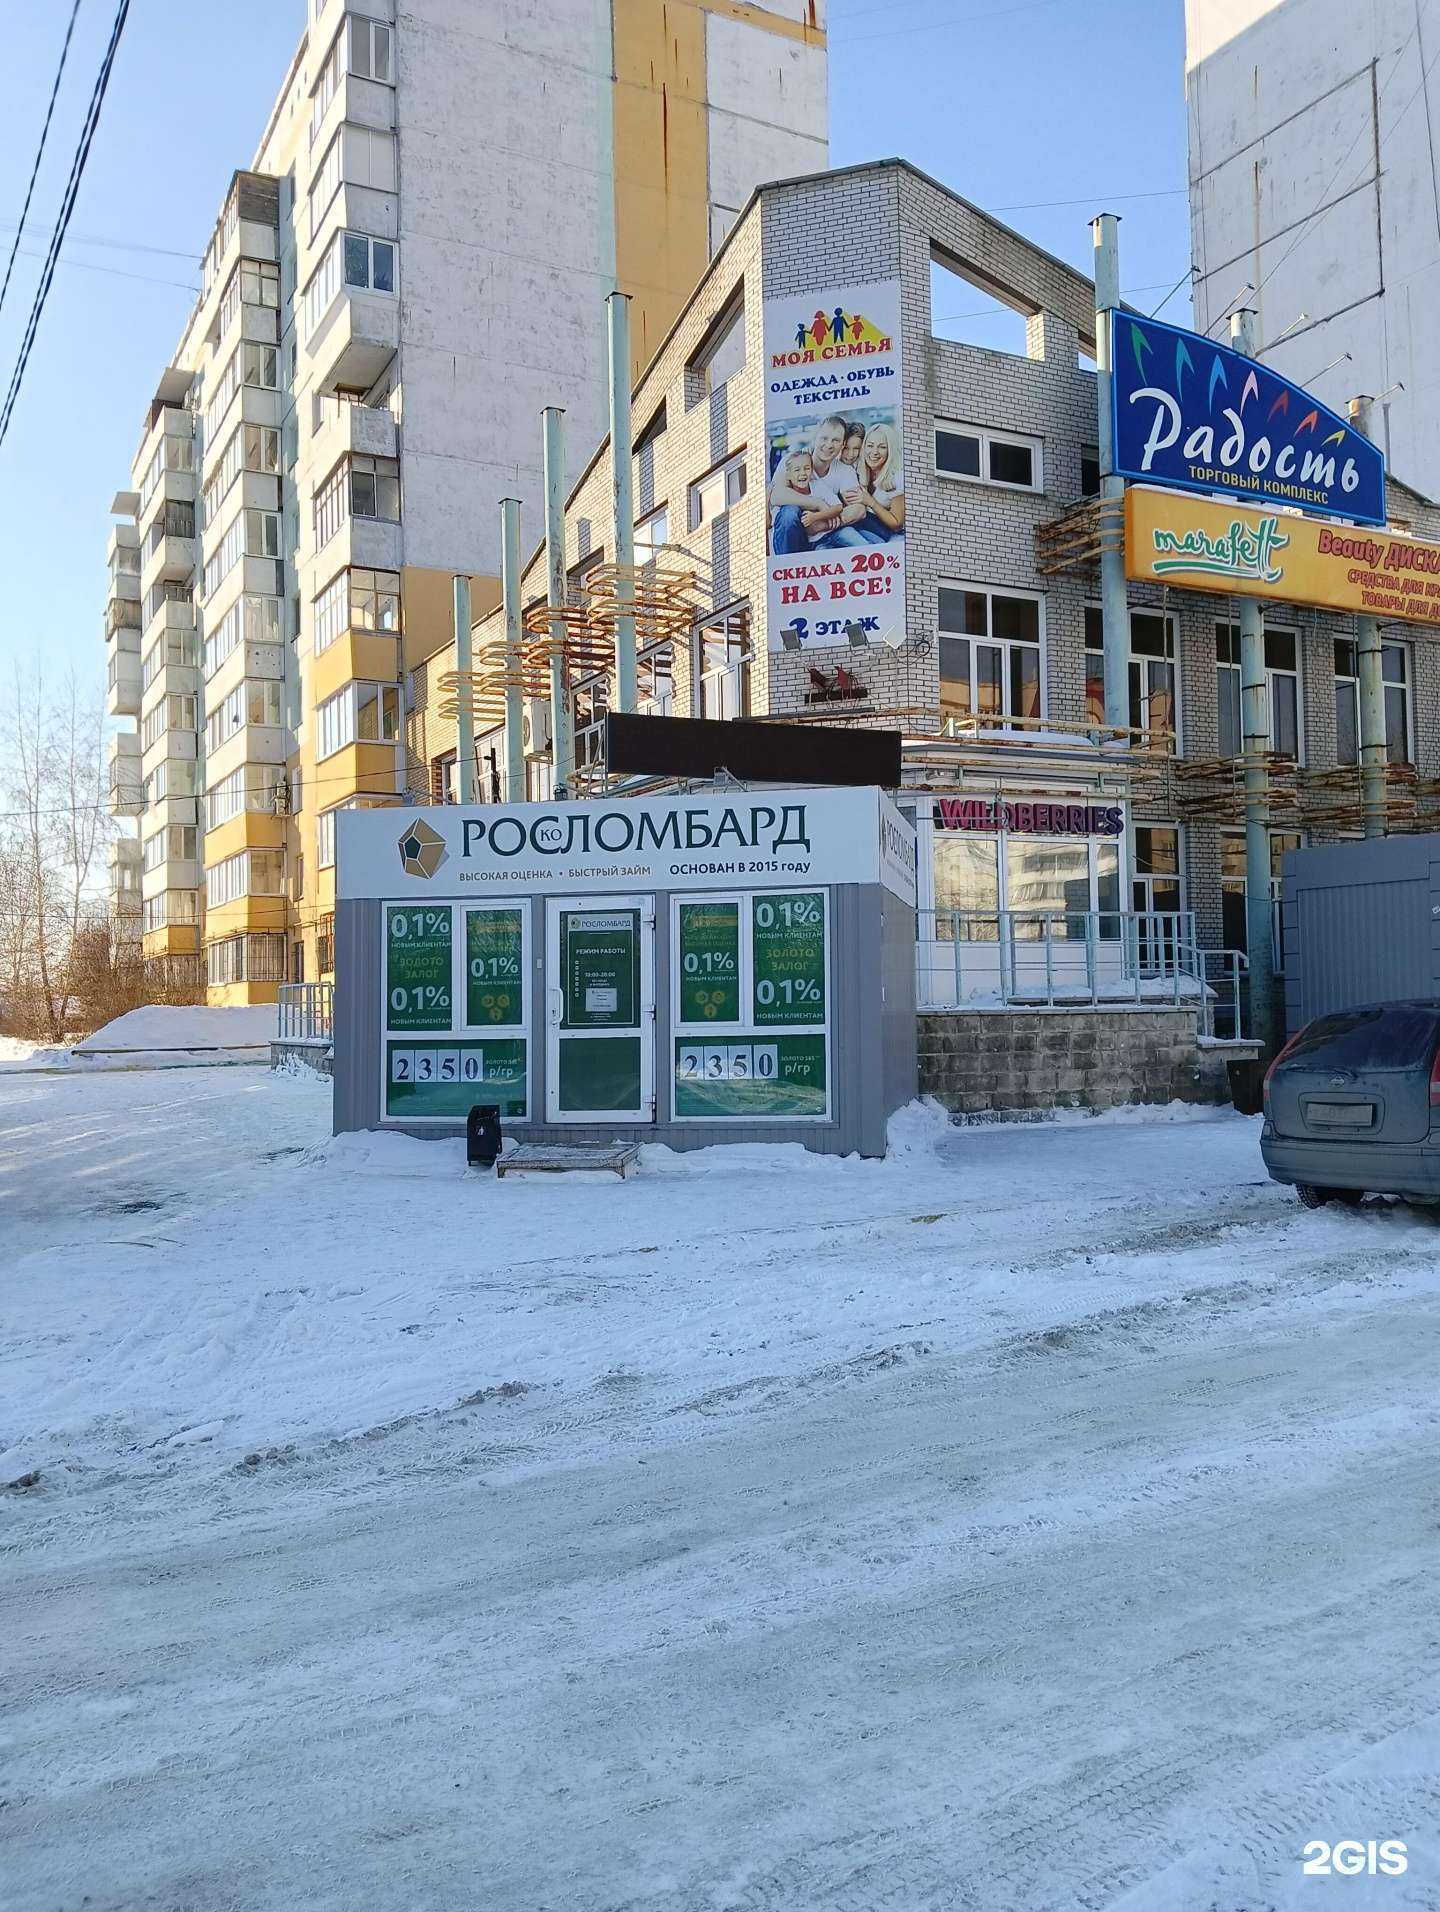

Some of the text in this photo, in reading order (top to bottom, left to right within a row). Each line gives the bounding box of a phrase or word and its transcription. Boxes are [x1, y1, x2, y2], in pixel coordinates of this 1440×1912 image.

[772, 338, 892, 368] МОЯ СЕМЬЯ
[770, 366, 895, 393] ОДЕЖДА ОБУВЬ
[794, 385, 871, 405] ТЕКСТИЛЬ
[1129, 387, 1360, 493] Радость
[1188, 464, 1329, 504] ТОРГОВЫЙ КОМПЛЕКС
[1318, 528, 1384, 569] Beauty
[772, 552, 900, 581] СКИДКА 20%
[781, 576, 892, 604] НА ВСЕ!
[1348, 569, 1401, 591] СРЕДСТВА
[1401, 578, 1425, 595] ДЛЯ
[1362, 591, 1406, 611] ТОВАРЫ
[1406, 599, 1429, 616] ДЛЯ
[789, 617, 809, 639] 2
[937, 799, 1125, 835] WILDBERRIES
[459, 861, 811, 881] ВЫСОКАЯ ОЦЕНКА БЫСТРЫЙ ЗАЙМ ОСНОВАН В 2015 году
[391, 913, 450, 940] 0,1%
[582, 920, 631, 928] РОСЛОМБАРД
[756, 902, 820, 930] 0,1%
[684, 952, 734, 975] 0,1%
[766, 948, 815, 959] ЗОЛОТО
[772, 961, 808, 971] ЗАЛОГ
[471, 957, 519, 979] 0,1%
[391, 986, 450, 1014] 0,1%
[757, 979, 821, 1008] 0,1%
[397, 1058, 479, 1080] 2350
[685, 1053, 773, 1078] 2350
[785, 1062, 811, 1076] р/гр
